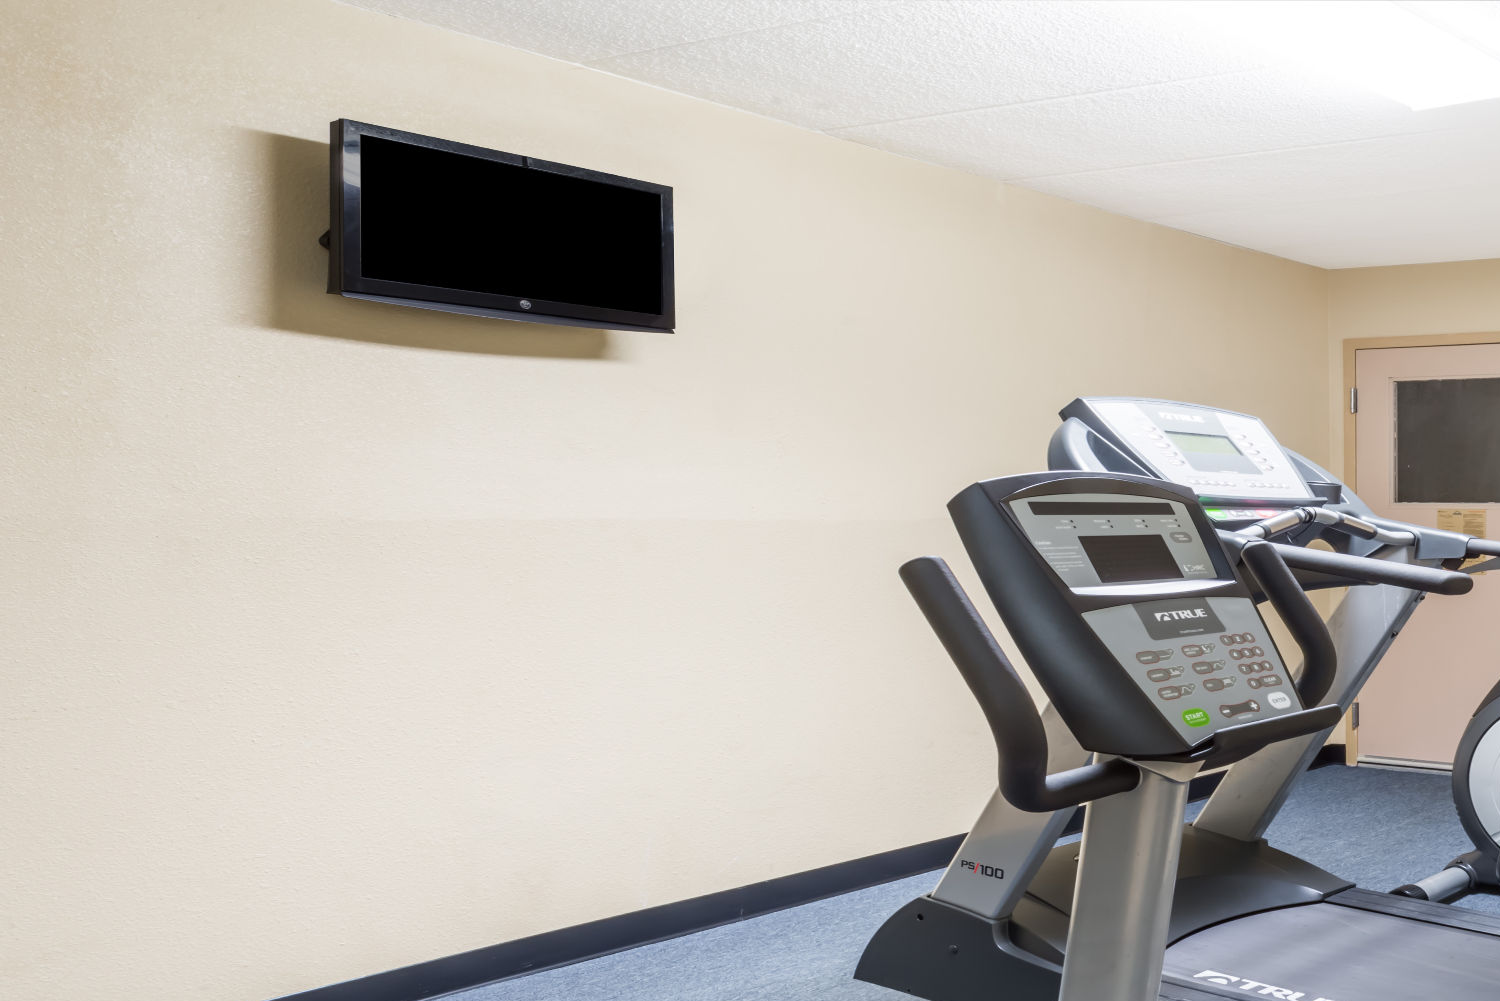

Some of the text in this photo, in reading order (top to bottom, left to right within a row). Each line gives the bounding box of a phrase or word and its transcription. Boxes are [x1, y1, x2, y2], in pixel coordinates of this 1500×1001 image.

[1168, 608, 1208, 620] TRUE
[1185, 711, 1204, 721] START
[961, 859, 1004, 879] PS/100
